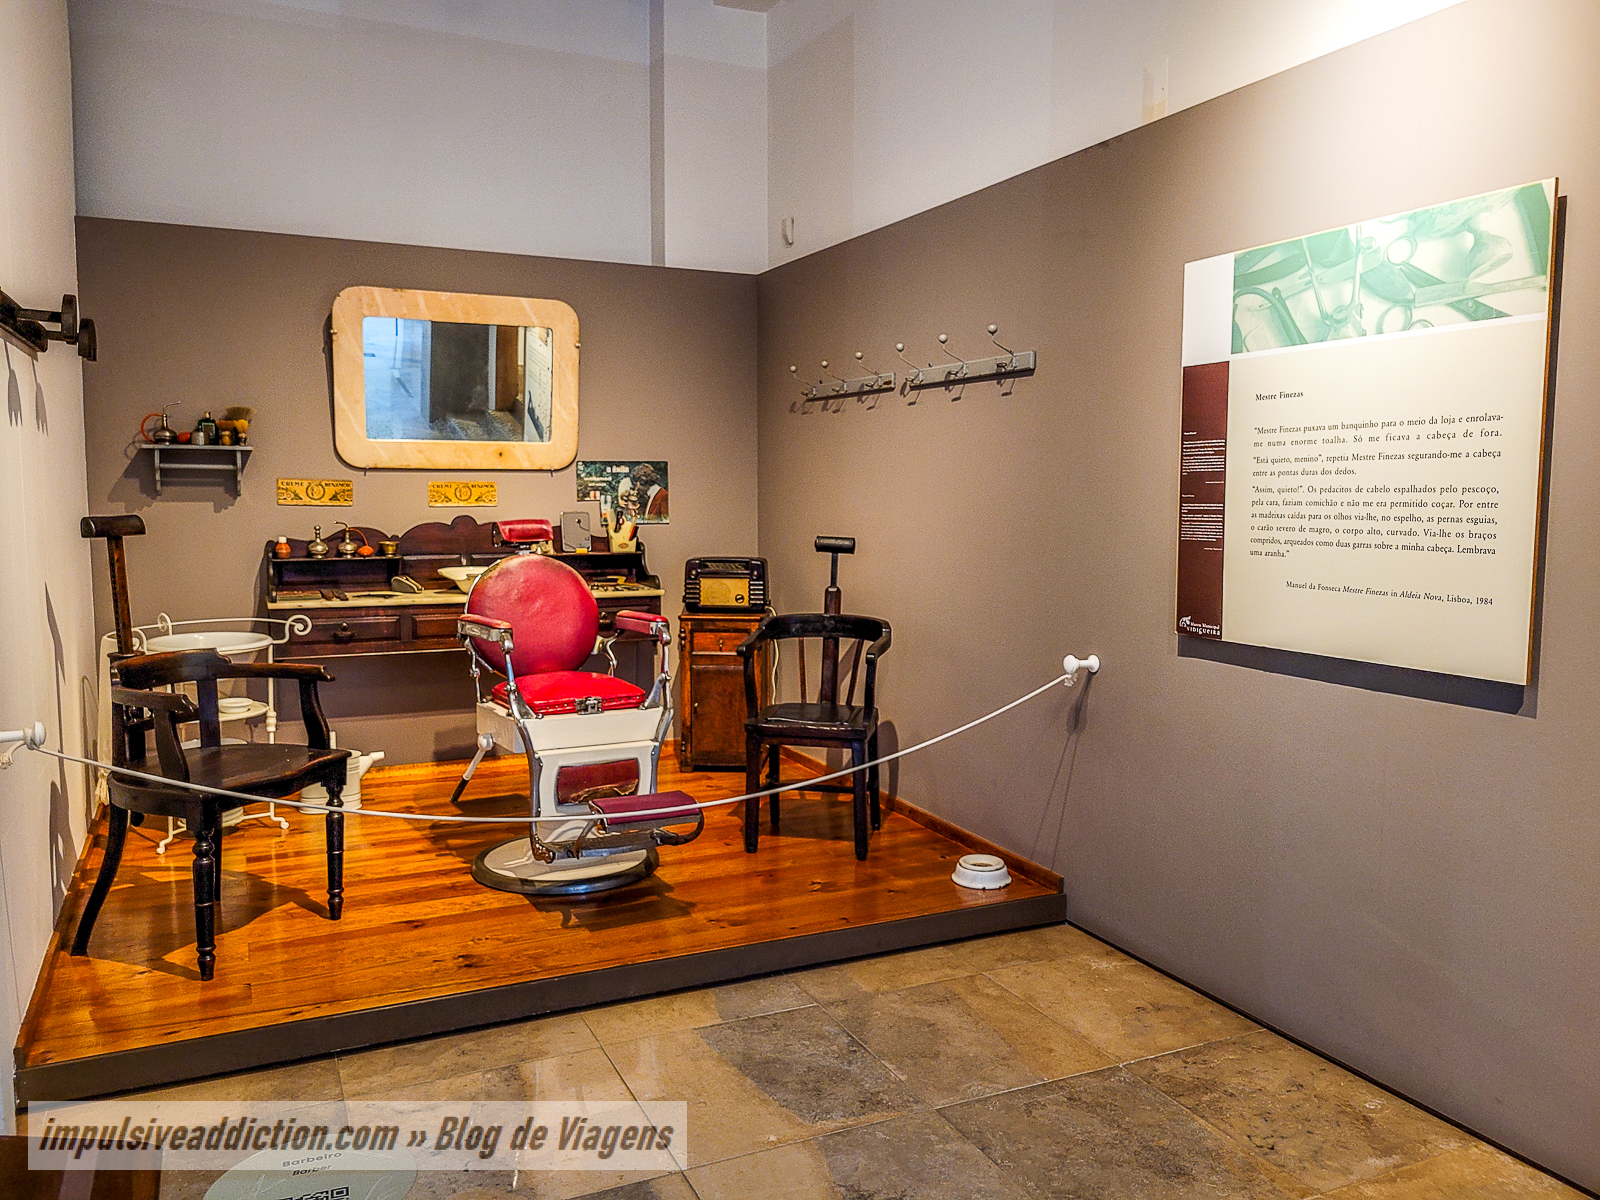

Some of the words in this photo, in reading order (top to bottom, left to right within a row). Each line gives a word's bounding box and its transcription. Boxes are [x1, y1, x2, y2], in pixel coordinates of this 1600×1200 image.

[1303, 425, 1326, 434] puxava
[1341, 420, 1378, 431] banquinho
[1381, 421, 1396, 430] para
[1407, 417, 1426, 426] meio
[1428, 416, 1438, 425] da
[1441, 415, 1456, 425] loja
[1465, 412, 1504, 423] enrolava-
[1322, 436, 1348, 444] toalha.
[1353, 435, 1362, 443] Só
[1385, 433, 1410, 442] ficava
[1426, 430, 1456, 440] cabeça
[1462, 429, 1474, 438] de
[1480, 428, 1502, 437] fora.
[1270, 457, 1292, 465] quieto,
[1326, 455, 1348, 464] repetia
[1351, 453, 1376, 461] Mestre
[1378, 452, 1405, 460] Finezas
[1407, 450, 1462, 462] segurando-me
[1472, 448, 1501, 459] cabeça
[1320, 467, 1332, 475] dos
[1334, 467, 1356, 475] dedos.
[1319, 485, 1352, 495] pedacitos
[1354, 485, 1364, 493] de
[1366, 484, 1390, 493] cabelo
[1393, 484, 1436, 495] espalhados
[1439, 484, 1458, 496] pelo
[1461, 486, 1499, 496] pescoço,
[1251, 498, 1264, 508] pela
[1305, 498, 1338, 506] comichão
[1390, 499, 1428, 509] permitido
[1459, 499, 1474, 508] Por
[1333, 512, 1352, 520] olhos
[1354, 512, 1378, 522] via-lhe,
[1393, 513, 1424, 524] espelho,
[1437, 516, 1463, 525] pernas
[1466, 514, 1498, 526] esguias,
[1298, 524, 1306, 532] de
[1342, 528, 1364, 536] corpo
[1366, 527, 1383, 536] alto,
[1386, 528, 1420, 536] curvado.
[1423, 528, 1452, 538] Via-lhe
[1468, 530, 1496, 541] braços
[1250, 536, 1282, 545] compridos,
[1283, 538, 1314, 547] arqueados
[1335, 539, 1350, 548] duas
[1374, 541, 1393, 550] sobre
[1401, 542, 1424, 551] minha
[1426, 543, 1454, 554] cabeça.
[1457, 544, 1496, 555] Lembrava
[1286, 581, 1307, 589] Manuel
[1317, 583, 1340, 592] Fonseca
[1342, 586, 1364, 594] Mestre
[1365, 587, 1388, 596] Finezas
[1399, 590, 1421, 599] Aldeia
[1423, 592, 1444, 602] Nova,
[1446, 594, 1472, 605] Lisboa,
[1476, 597, 1492, 605] 1984
[282, 1152, 342, 1167] Barbeiro
[292, 1164, 332, 1176] Barber
